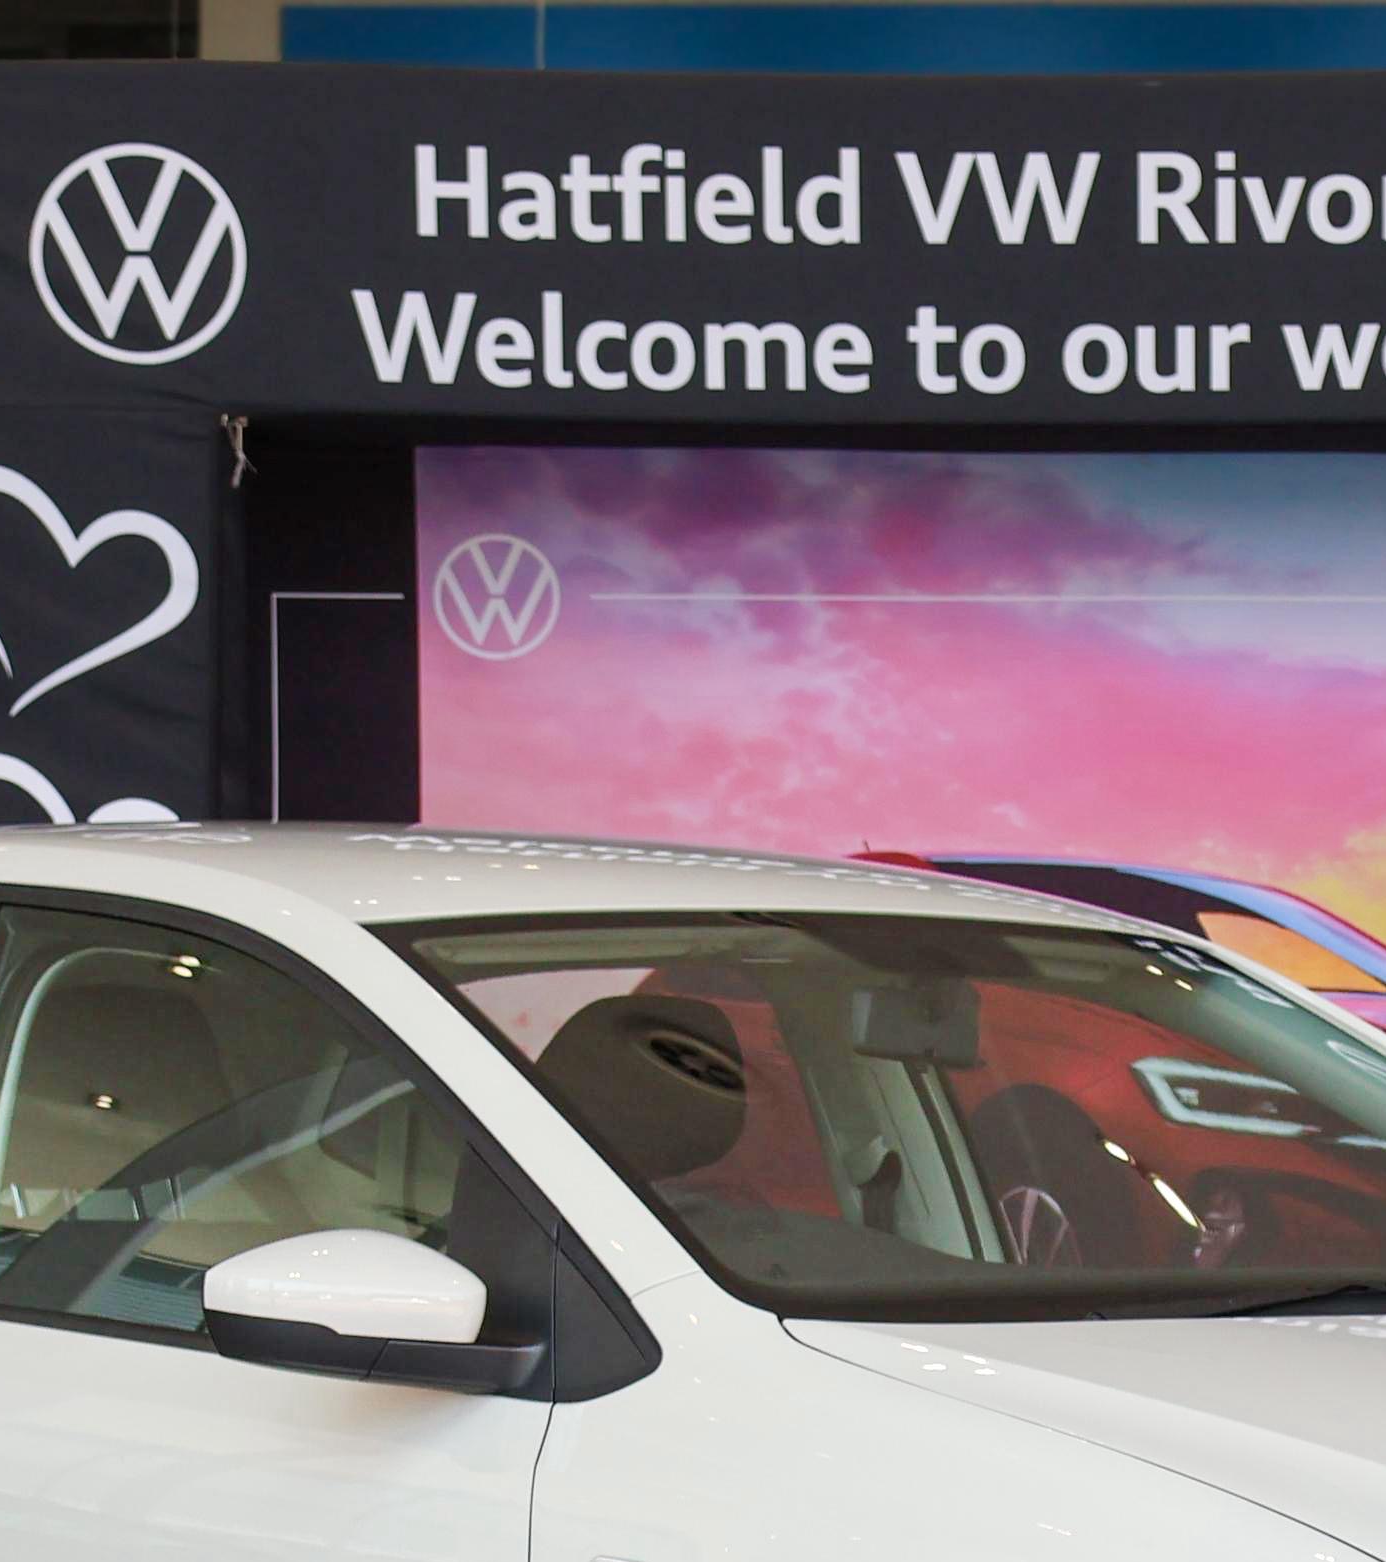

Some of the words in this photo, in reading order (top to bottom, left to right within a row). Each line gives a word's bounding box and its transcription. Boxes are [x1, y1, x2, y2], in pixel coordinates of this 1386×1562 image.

[415, 143, 861, 246] Hatfield
[896, 151, 1101, 245] VW
[30, 144, 246, 365] VW
[352, 289, 873, 393] Welcome
[907, 306, 1026, 394] to
[1062, 323, 1251, 394] our
